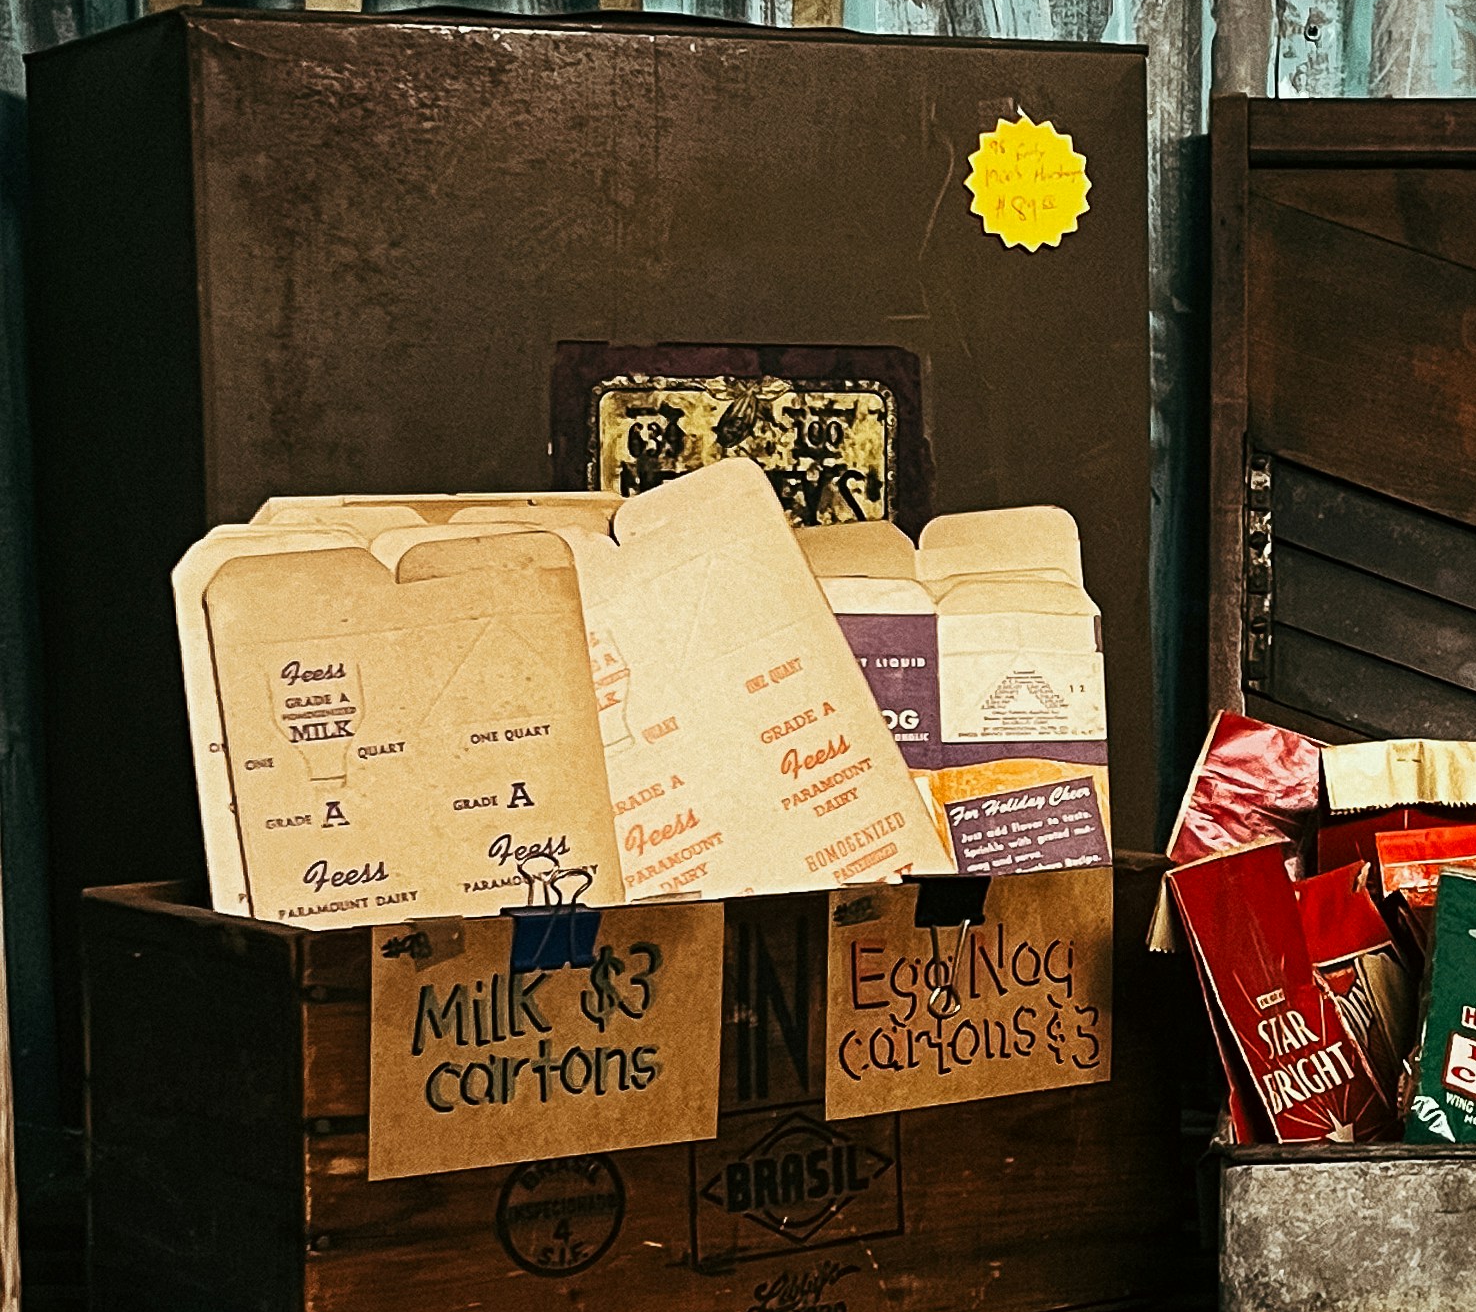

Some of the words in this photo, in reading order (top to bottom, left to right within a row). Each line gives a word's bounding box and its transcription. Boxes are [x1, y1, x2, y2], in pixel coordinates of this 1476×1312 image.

[875, 657, 927, 669] LIQUID
[284, 694, 333, 710] GRADE
[338, 691, 351, 703] A
[287, 719, 355, 744] MILK
[469, 730, 500, 745] ONE
[503, 724, 552, 741] QUART
[759, 708, 819, 745] GRADE
[821, 701, 837, 719] A
[244, 757, 275, 772] ONE
[357, 741, 407, 759] QUART
[452, 795, 499, 812] GRADE
[505, 781, 535, 810] A
[669, 774, 687, 791] A
[780, 757, 874, 811] PARAMOUNT
[264, 814, 313, 831] GRADE
[320, 800, 351, 829] A
[812, 787, 861, 818] DAIRY
[950, 805, 980, 827] For
[981, 794, 1047, 817] Holiday
[1048, 785, 1092, 807] Cheer
[963, 841, 1005, 859] Sprinkle
[1008, 835, 1032, 849] with
[1037, 827, 1071, 845] grated
[986, 825, 1009, 839] add
[1011, 820, 1044, 833] flavor
[1047, 816, 1060, 826] to
[624, 831, 723, 889] PARAMOUNT
[991, 854, 1013, 868] and
[660, 861, 711, 893] DAIRY
[277, 896, 370, 921] PARAMOUNT
[375, 890, 419, 908] DAIRY
[969, 922, 1075, 1010] Nog
[411, 972, 554, 1058] Milk
[579, 940, 664, 1034] $3
[838, 1004, 1037, 1081] cartons
[1257, 1009, 1320, 1060] STAR
[424, 1039, 662, 1114] cartons
[1262, 1041, 1355, 1115] BRIGHT
[1446, 1092, 1475, 1114] WING
[725, 1144, 871, 1214] BRASIL
